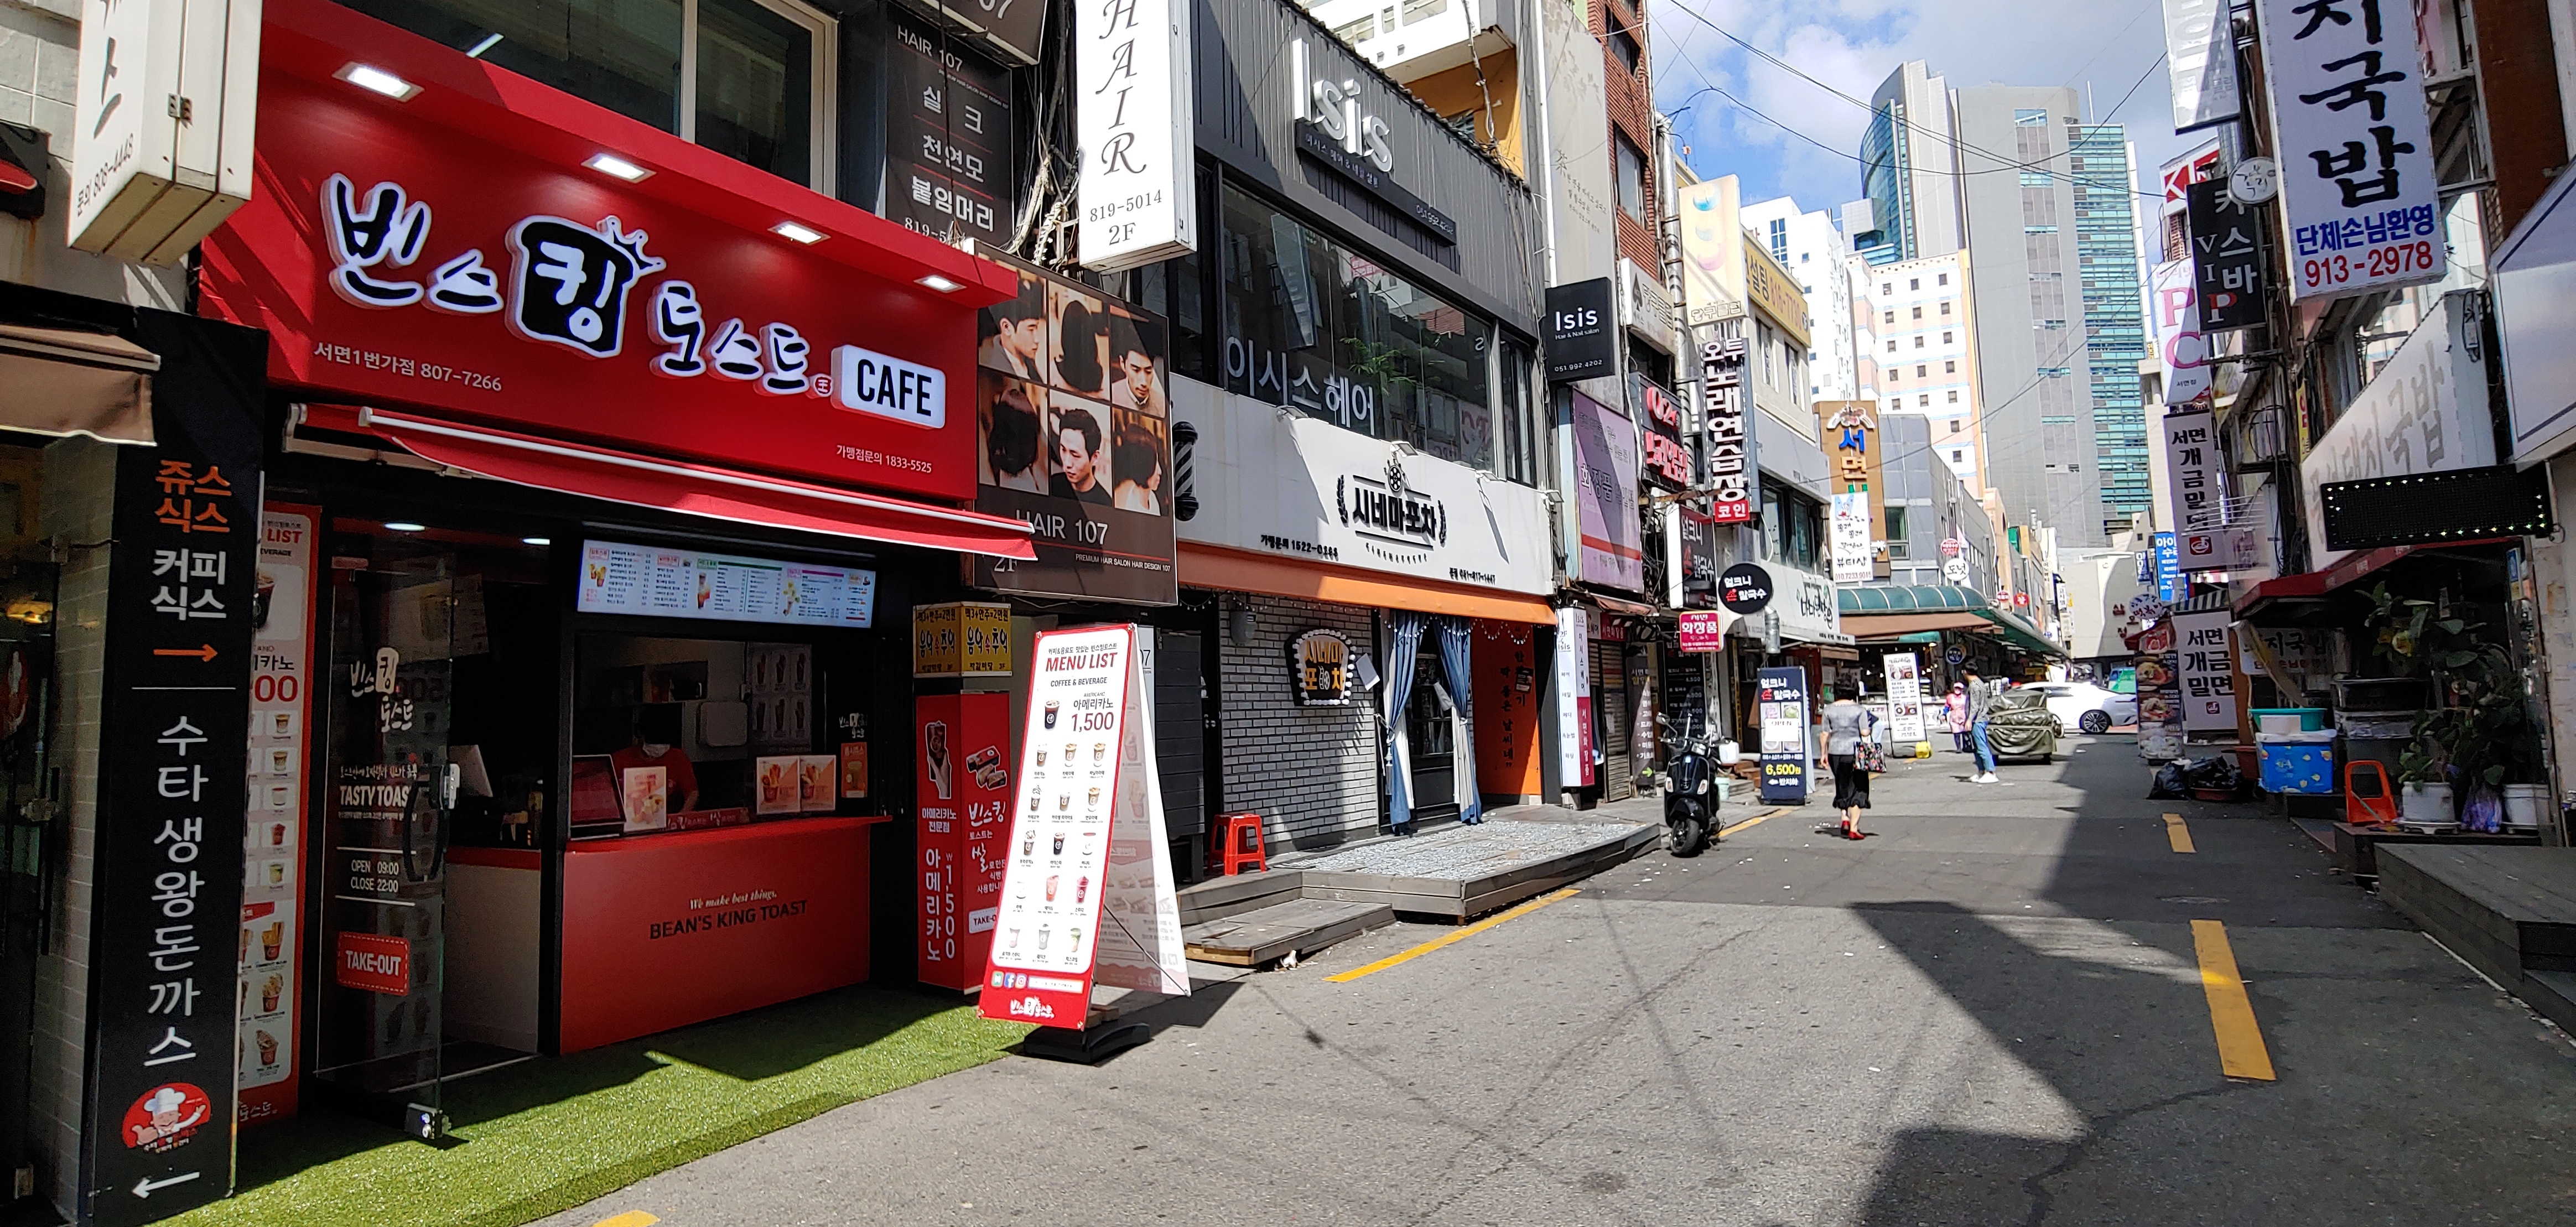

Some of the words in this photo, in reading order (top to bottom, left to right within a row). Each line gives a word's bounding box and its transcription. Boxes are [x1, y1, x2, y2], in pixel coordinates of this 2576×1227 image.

[897, 25, 932, 56] HAIR
[939, 49, 963, 72] 107
[1292, 38, 1392, 173] Isis
[922, 134, 984, 183] 천연모
[77, 179, 92, 217] 문의
[912, 175, 994, 232] 붙임머리
[1090, 189, 1162, 222] 819-5014
[1109, 222, 1136, 246] 2F
[2296, 203, 2434, 256] 단체손님환영
[2305, 241, 2433, 288] 913-2978
[1555, 307, 1598, 331] Isis
[647, 280, 811, 394] 토스트
[1704, 338, 1745, 361] 오투
[314, 341, 415, 377] 서면1번가점
[420, 363, 502, 392] 807-7266
[856, 358, 933, 417] CAFE
[1226, 336, 1376, 436] 이시스헤어
[1706, 366, 1748, 502] 노래연습장
[2172, 428, 2206, 444] 서면
[837, 444, 882, 466] 가맹점문의
[885, 454, 933, 474] 1833-5525
[1839, 429, 1868, 480] 서면
[155, 460, 232, 497] 쥬스
[1581, 464, 1613, 502] 화장품
[155, 498, 230, 533] 식스
[1353, 487, 1437, 539] 시네마포차
[1718, 506, 1746, 518] 코인
[267, 529, 303, 544] LIST
[1016, 509, 1066, 539] HAIR
[1075, 519, 1108, 545] 107
[1681, 515, 1703, 545] 얼크니
[260, 548, 292, 557] EVERAGE
[1076, 554, 1099, 564] PREMIUM
[1100, 557, 1113, 565] HAIR
[1114, 558, 1130, 567] SALON
[1144, 563, 1161, 571] DESIGN
[152, 549, 226, 585] 커피
[1946, 563, 1966, 575] 도넛
[1725, 576, 1752, 588] 얼크니
[150, 586, 226, 621] 식스
[1681, 622, 1717, 635] 화장품
[2188, 628, 2225, 646] 서면
[1046, 656, 1086, 672] MENU
[1089, 652, 1118, 667] LIST
[1305, 641, 1344, 664] 시네마
[2184, 651, 2231, 672] 개금
[1051, 679, 1071, 688] COFFEE
[1078, 677, 1107, 685] BEVERAGE
[1760, 677, 1788, 689] 얼크니
[2188, 675, 2236, 697] 밀면
[1073, 698, 1114, 711] 아메리카노
[1071, 711, 1114, 733] 1,500
[1779, 778, 1799, 786] 반지하
[340, 786, 375, 806] TASTY
[377, 786, 412, 807] TOAS
[922, 807, 957, 819] 아메리카노
[969, 801, 1006, 827] 빈스킹
[928, 821, 951, 833] 전문점
[351, 860, 371, 873] OPEN
[377, 862, 399, 876] 09:00
[972, 843, 988, 873] 쌀
[351, 876, 375, 890] CLOSE
[377, 878, 398, 893] 22:00
[690, 898, 703, 911] We
[705, 895, 730, 908] make
[732, 891, 749, 904] best
[750, 888, 777, 901] things.
[926, 849, 942, 961] 아메리카노
[945, 864, 955, 959] 1,500
[650, 914, 712, 939] BEAN'S
[717, 908, 756, 928] KING
[760, 900, 807, 921] TOAST
[974, 914, 996, 926] TAKE-O
[346, 949, 401, 976] TAKE-OUT
